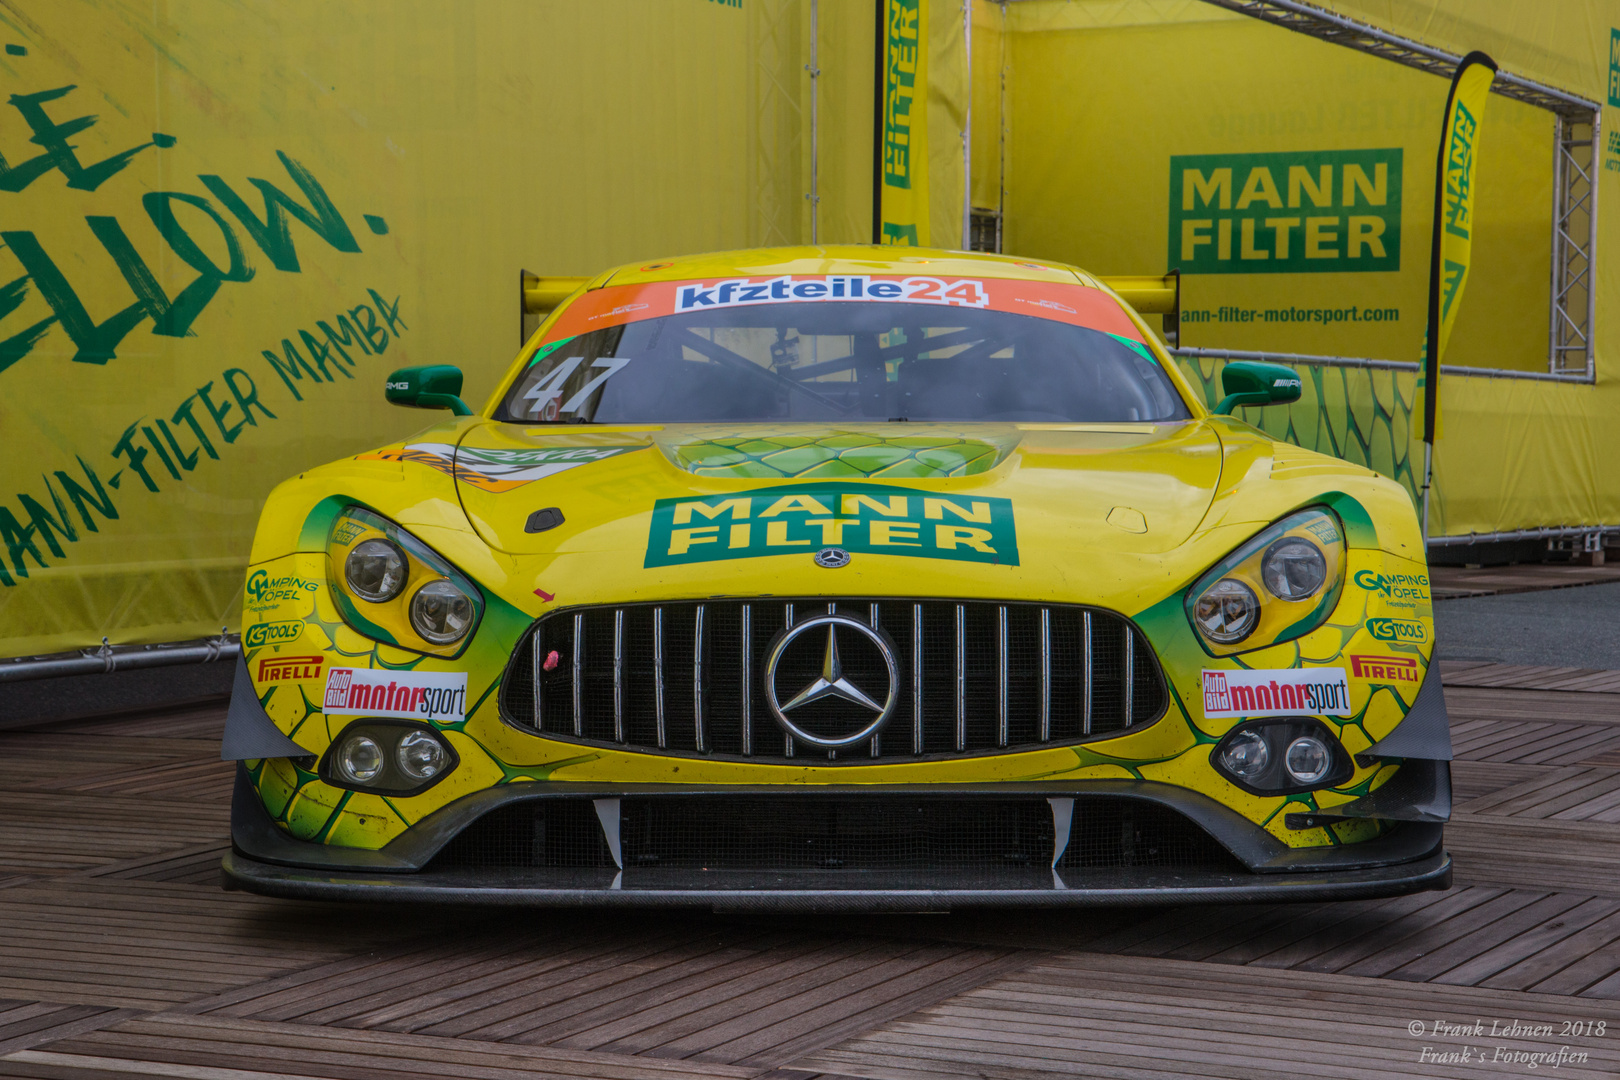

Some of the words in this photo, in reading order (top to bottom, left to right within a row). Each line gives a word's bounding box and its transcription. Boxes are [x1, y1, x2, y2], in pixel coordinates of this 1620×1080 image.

[893, 6, 918, 177] FILTER
[1446, 108, 1467, 224] MANN
[1182, 163, 1388, 210] MANN
[1181, 215, 1387, 260] FILTER
[681, 277, 982, 308] kfzteile24
[261, 287, 409, 401] MAMBA
[386, 381, 409, 390] AMG
[523, 356, 631, 413] 47
[672, 494, 992, 525] MANN
[667, 518, 998, 556] FILTER
[247, 570, 319, 595] CAMPING
[1354, 570, 1428, 591] CAMPING
[267, 624, 299, 639] TOOLS
[1392, 622, 1424, 639] TOOLS
[258, 656, 324, 682] PIRELLI
[327, 671, 351, 689] Auto
[1350, 655, 1418, 682] PIRELLI
[1204, 674, 1226, 692] Auto
[326, 689, 347, 706] Bild
[1206, 691, 1230, 710] Bild
